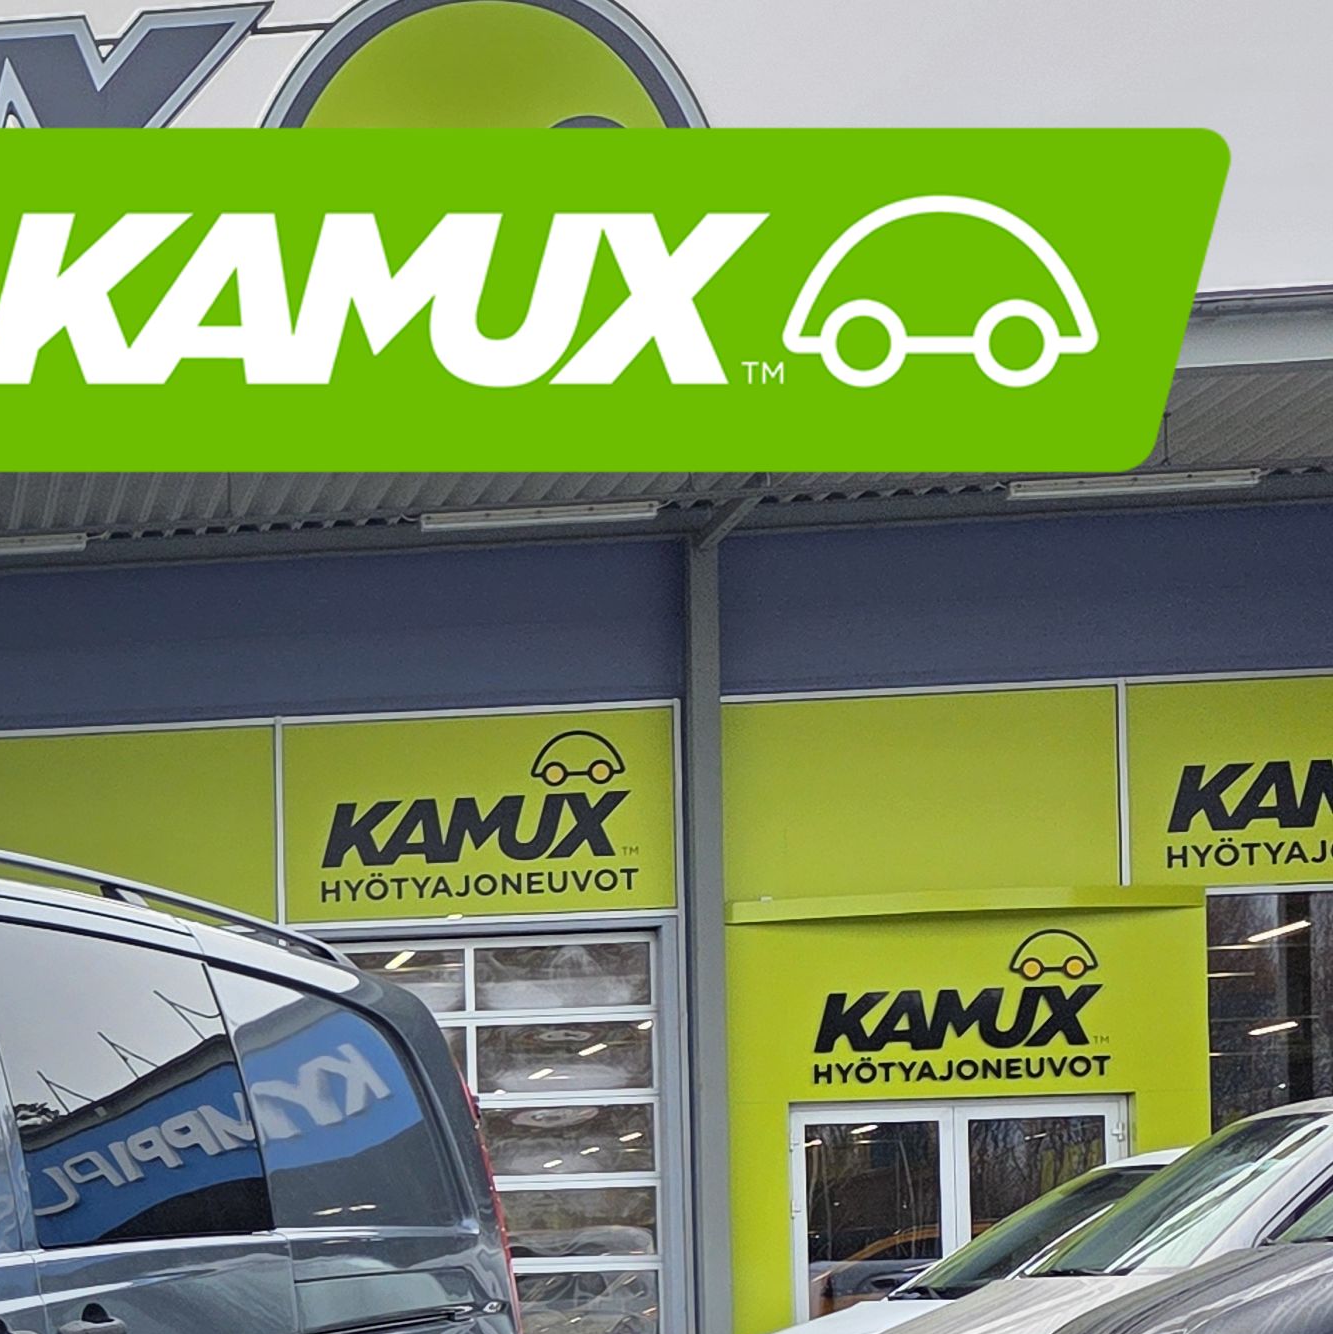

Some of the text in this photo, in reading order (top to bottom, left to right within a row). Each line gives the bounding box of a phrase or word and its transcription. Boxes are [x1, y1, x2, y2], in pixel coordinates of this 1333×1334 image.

[322, 790, 631, 868] KAMUX
[321, 868, 639, 902] HYÖTYAJONEUVOT
[814, 984, 1103, 1053] KAMUX
[813, 1056, 1111, 1085] HYÖTYAJONEUVOT
